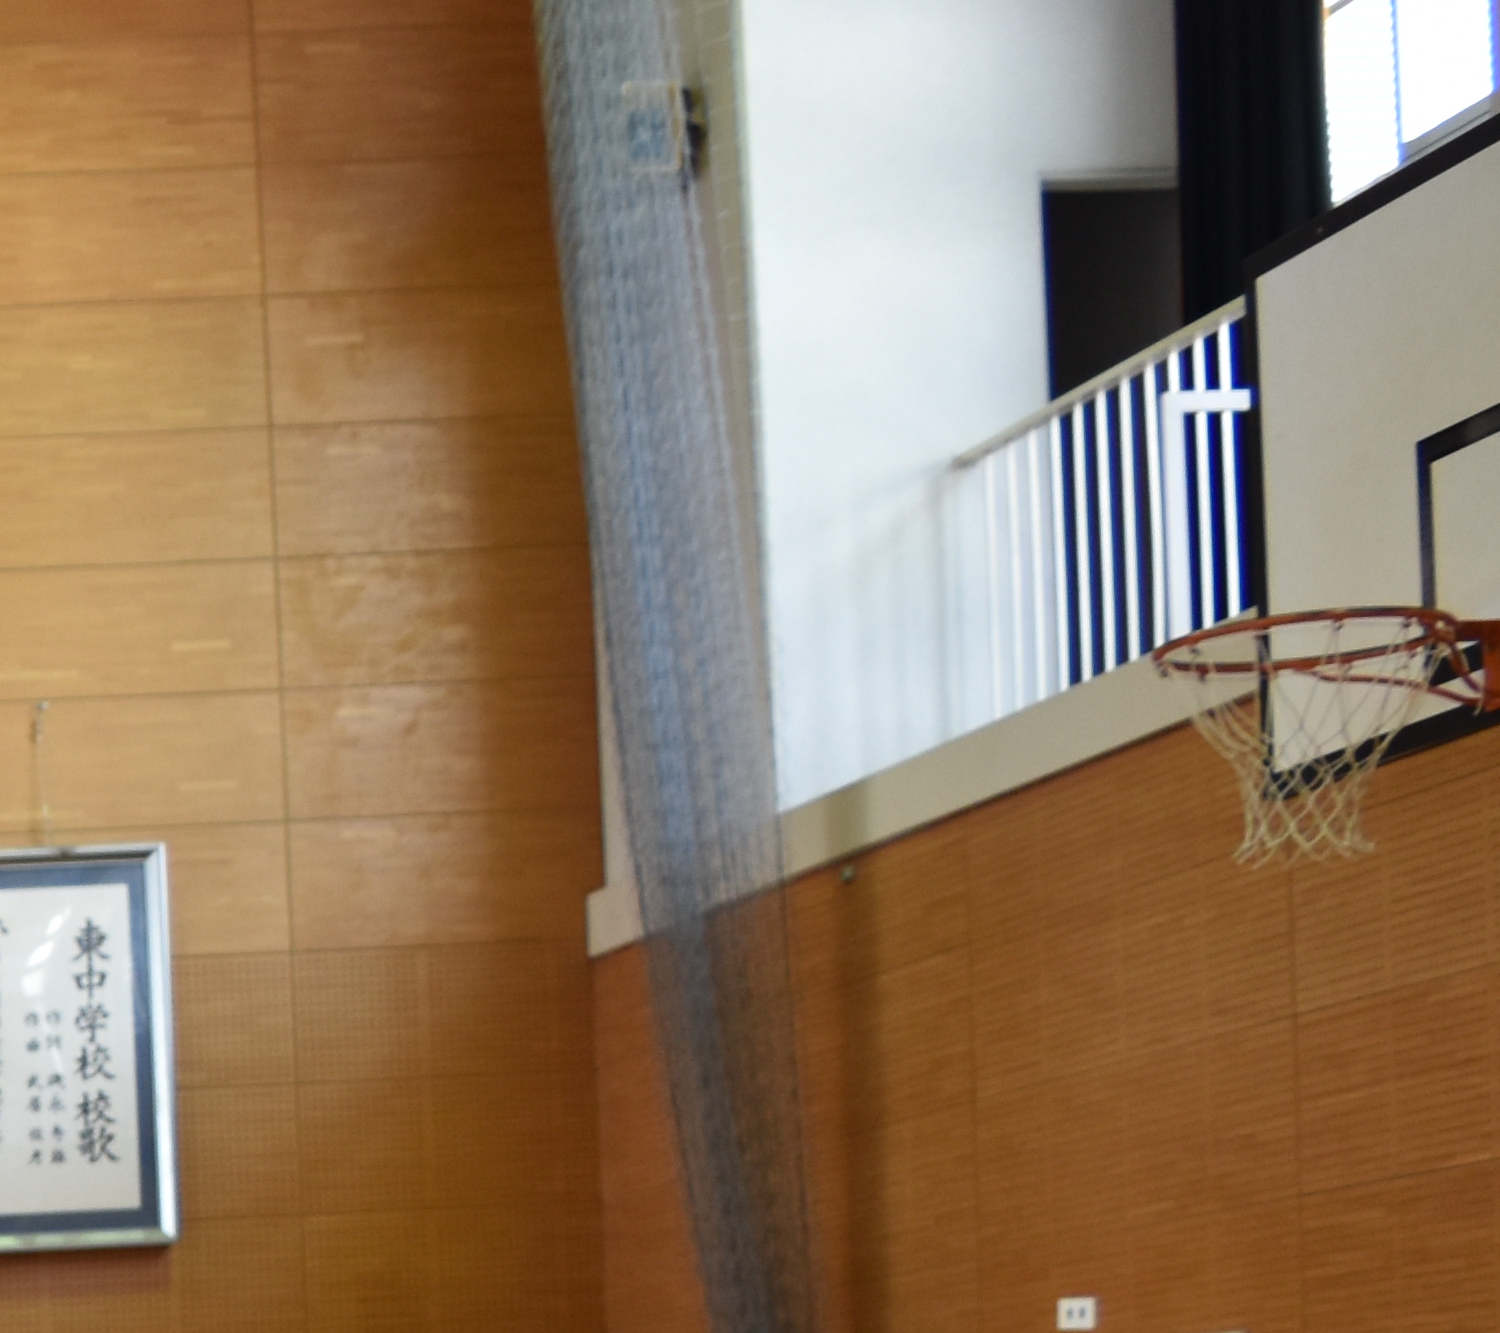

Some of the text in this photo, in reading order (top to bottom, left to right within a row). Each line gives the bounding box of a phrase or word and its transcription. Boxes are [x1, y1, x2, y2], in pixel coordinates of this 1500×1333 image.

[73, 917, 120, 1164] 東中学校 校歌
